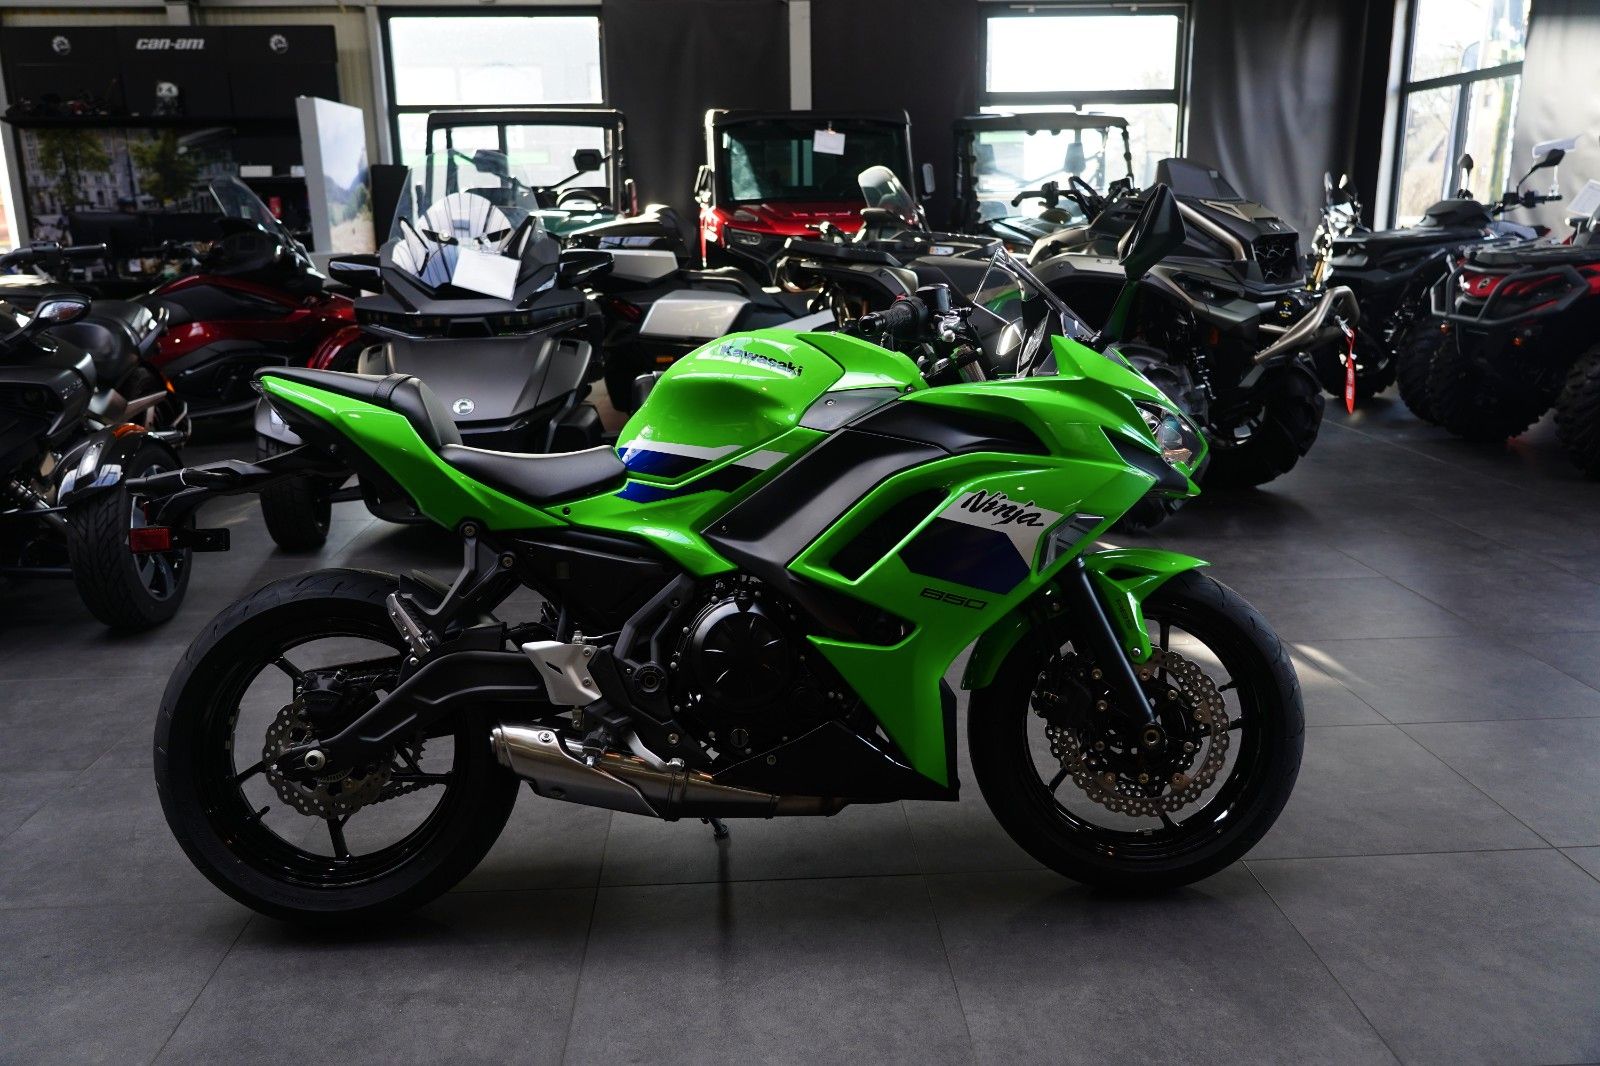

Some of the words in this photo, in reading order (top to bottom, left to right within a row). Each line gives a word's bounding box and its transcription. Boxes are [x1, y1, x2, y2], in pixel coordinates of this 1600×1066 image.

[136, 38, 205, 50] can-am
[720, 345, 804, 377] Kawasaki
[960, 490, 1045, 527] Ninja
[919, 587, 989, 610] 650
